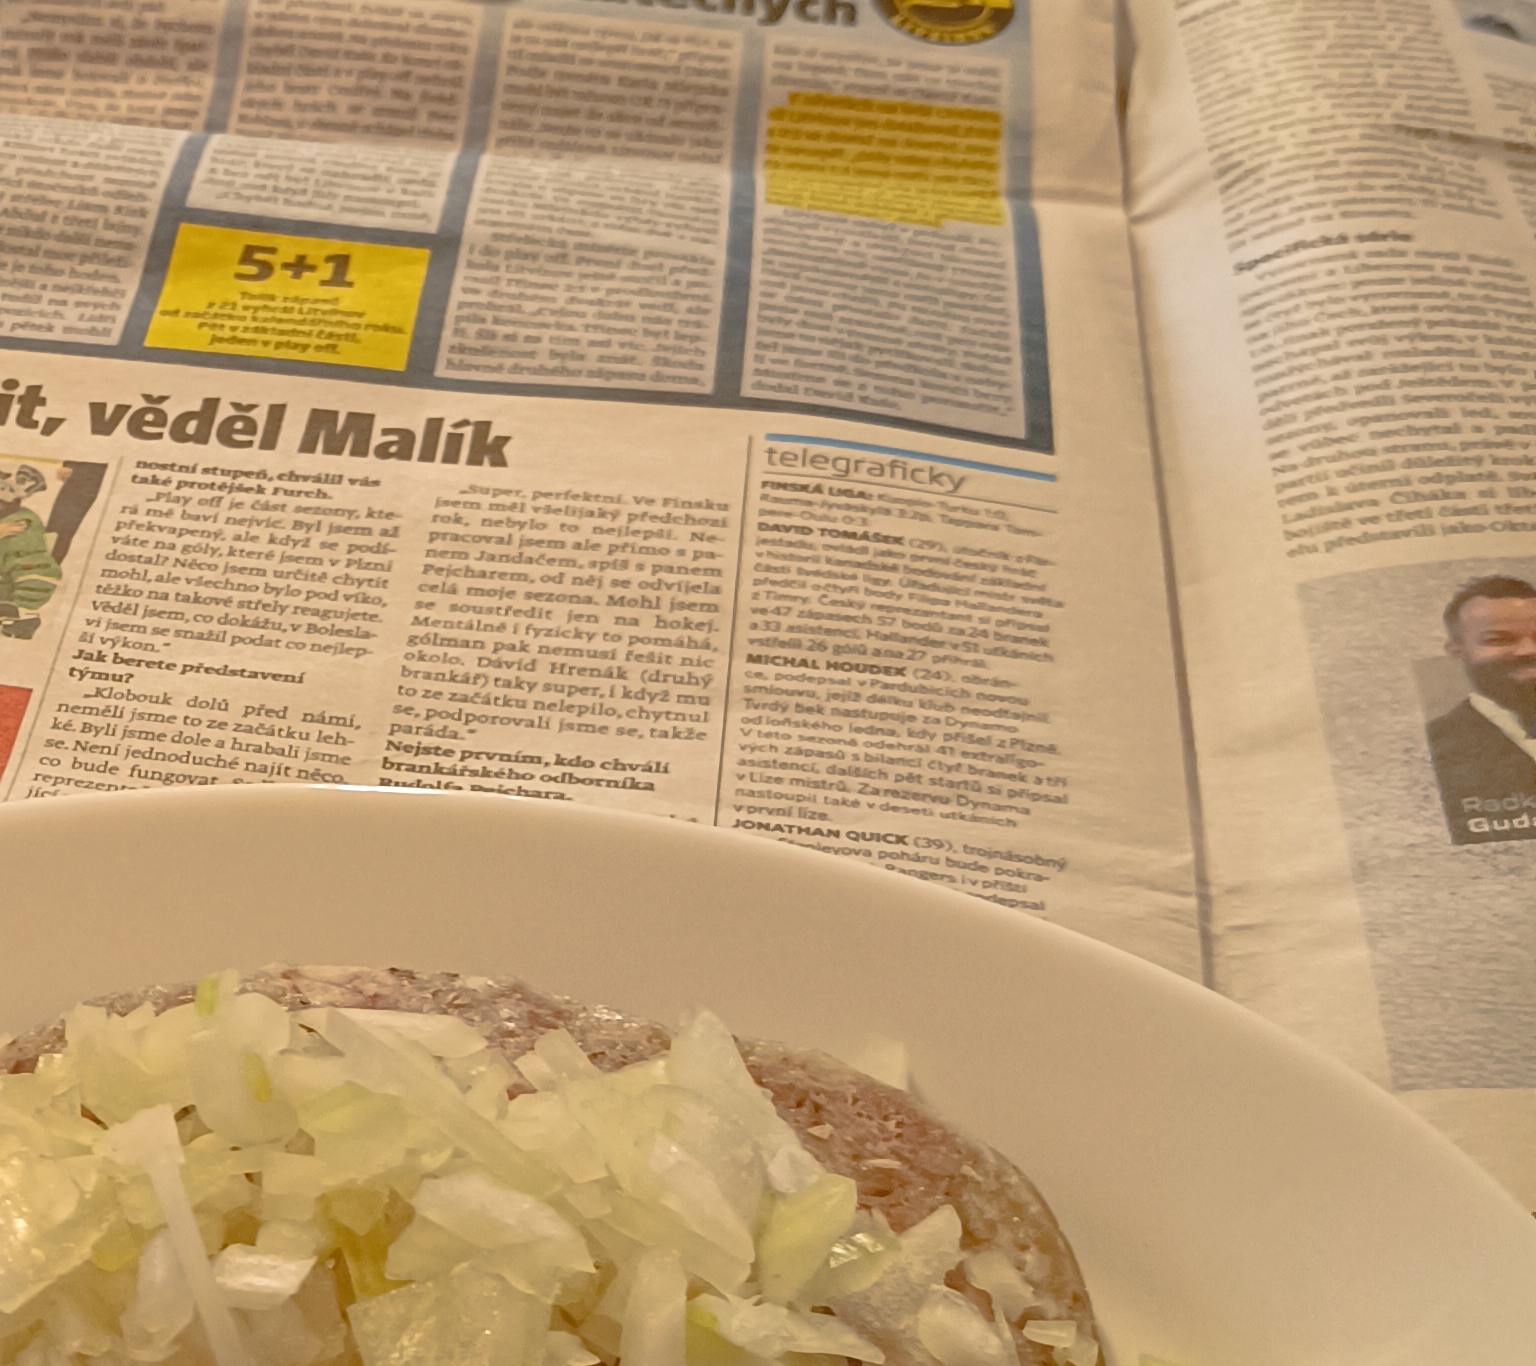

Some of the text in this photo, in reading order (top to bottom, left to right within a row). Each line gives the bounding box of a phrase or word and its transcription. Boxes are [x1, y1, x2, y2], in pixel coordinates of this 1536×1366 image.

[233, 244, 356, 288] 5+1
[89, 394, 286, 450] věděl
[297, 408, 514, 469] Malík
[764, 446, 965, 493] telegraficky
[730, 818, 909, 846] JONATHAN QUICK
